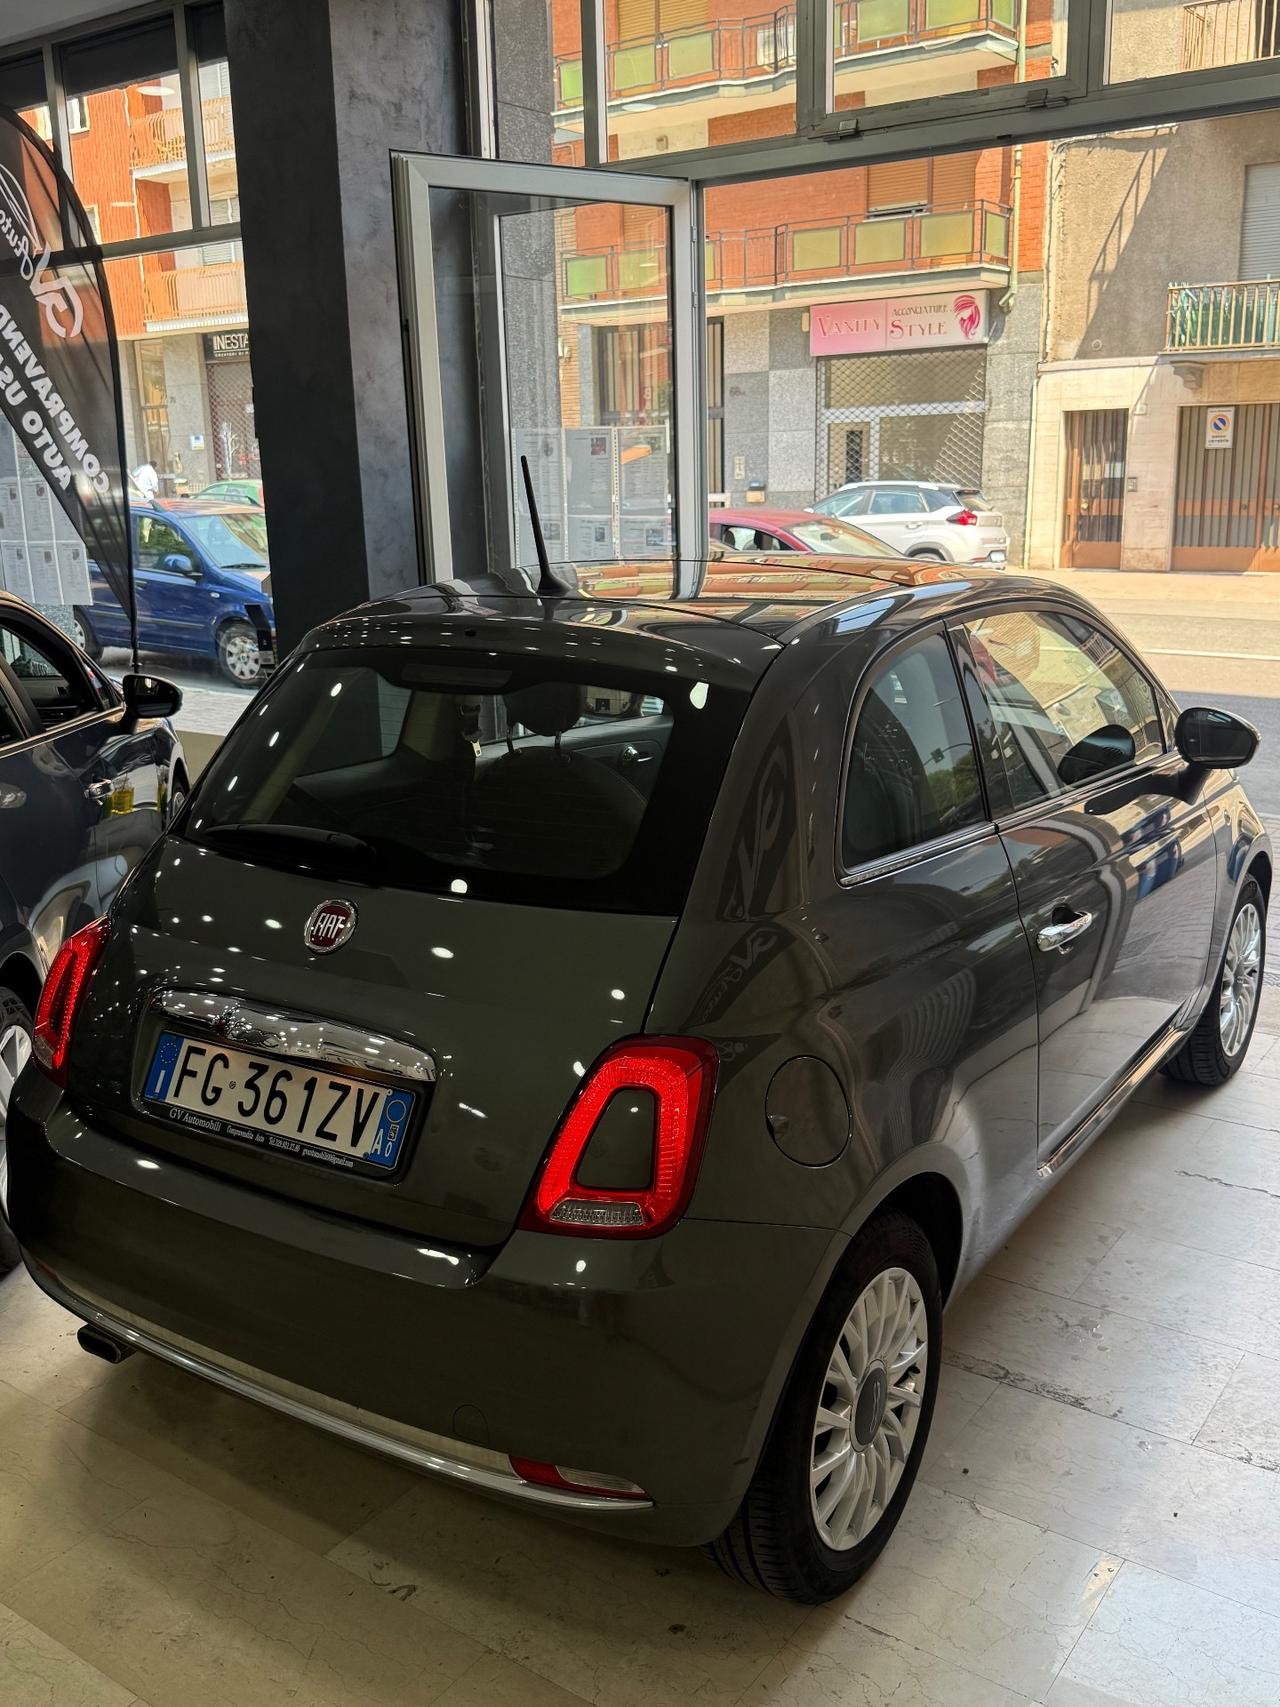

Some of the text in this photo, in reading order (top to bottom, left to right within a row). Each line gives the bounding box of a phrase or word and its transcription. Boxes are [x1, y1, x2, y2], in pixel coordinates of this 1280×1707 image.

[312, 912, 346, 939] FIAT
[154, 1069, 167, 1094] I
[173, 1045, 380, 1148] FG 361ZV
[169, 1107, 184, 1120] GV
[182, 1113, 222, 1132] Automobili
